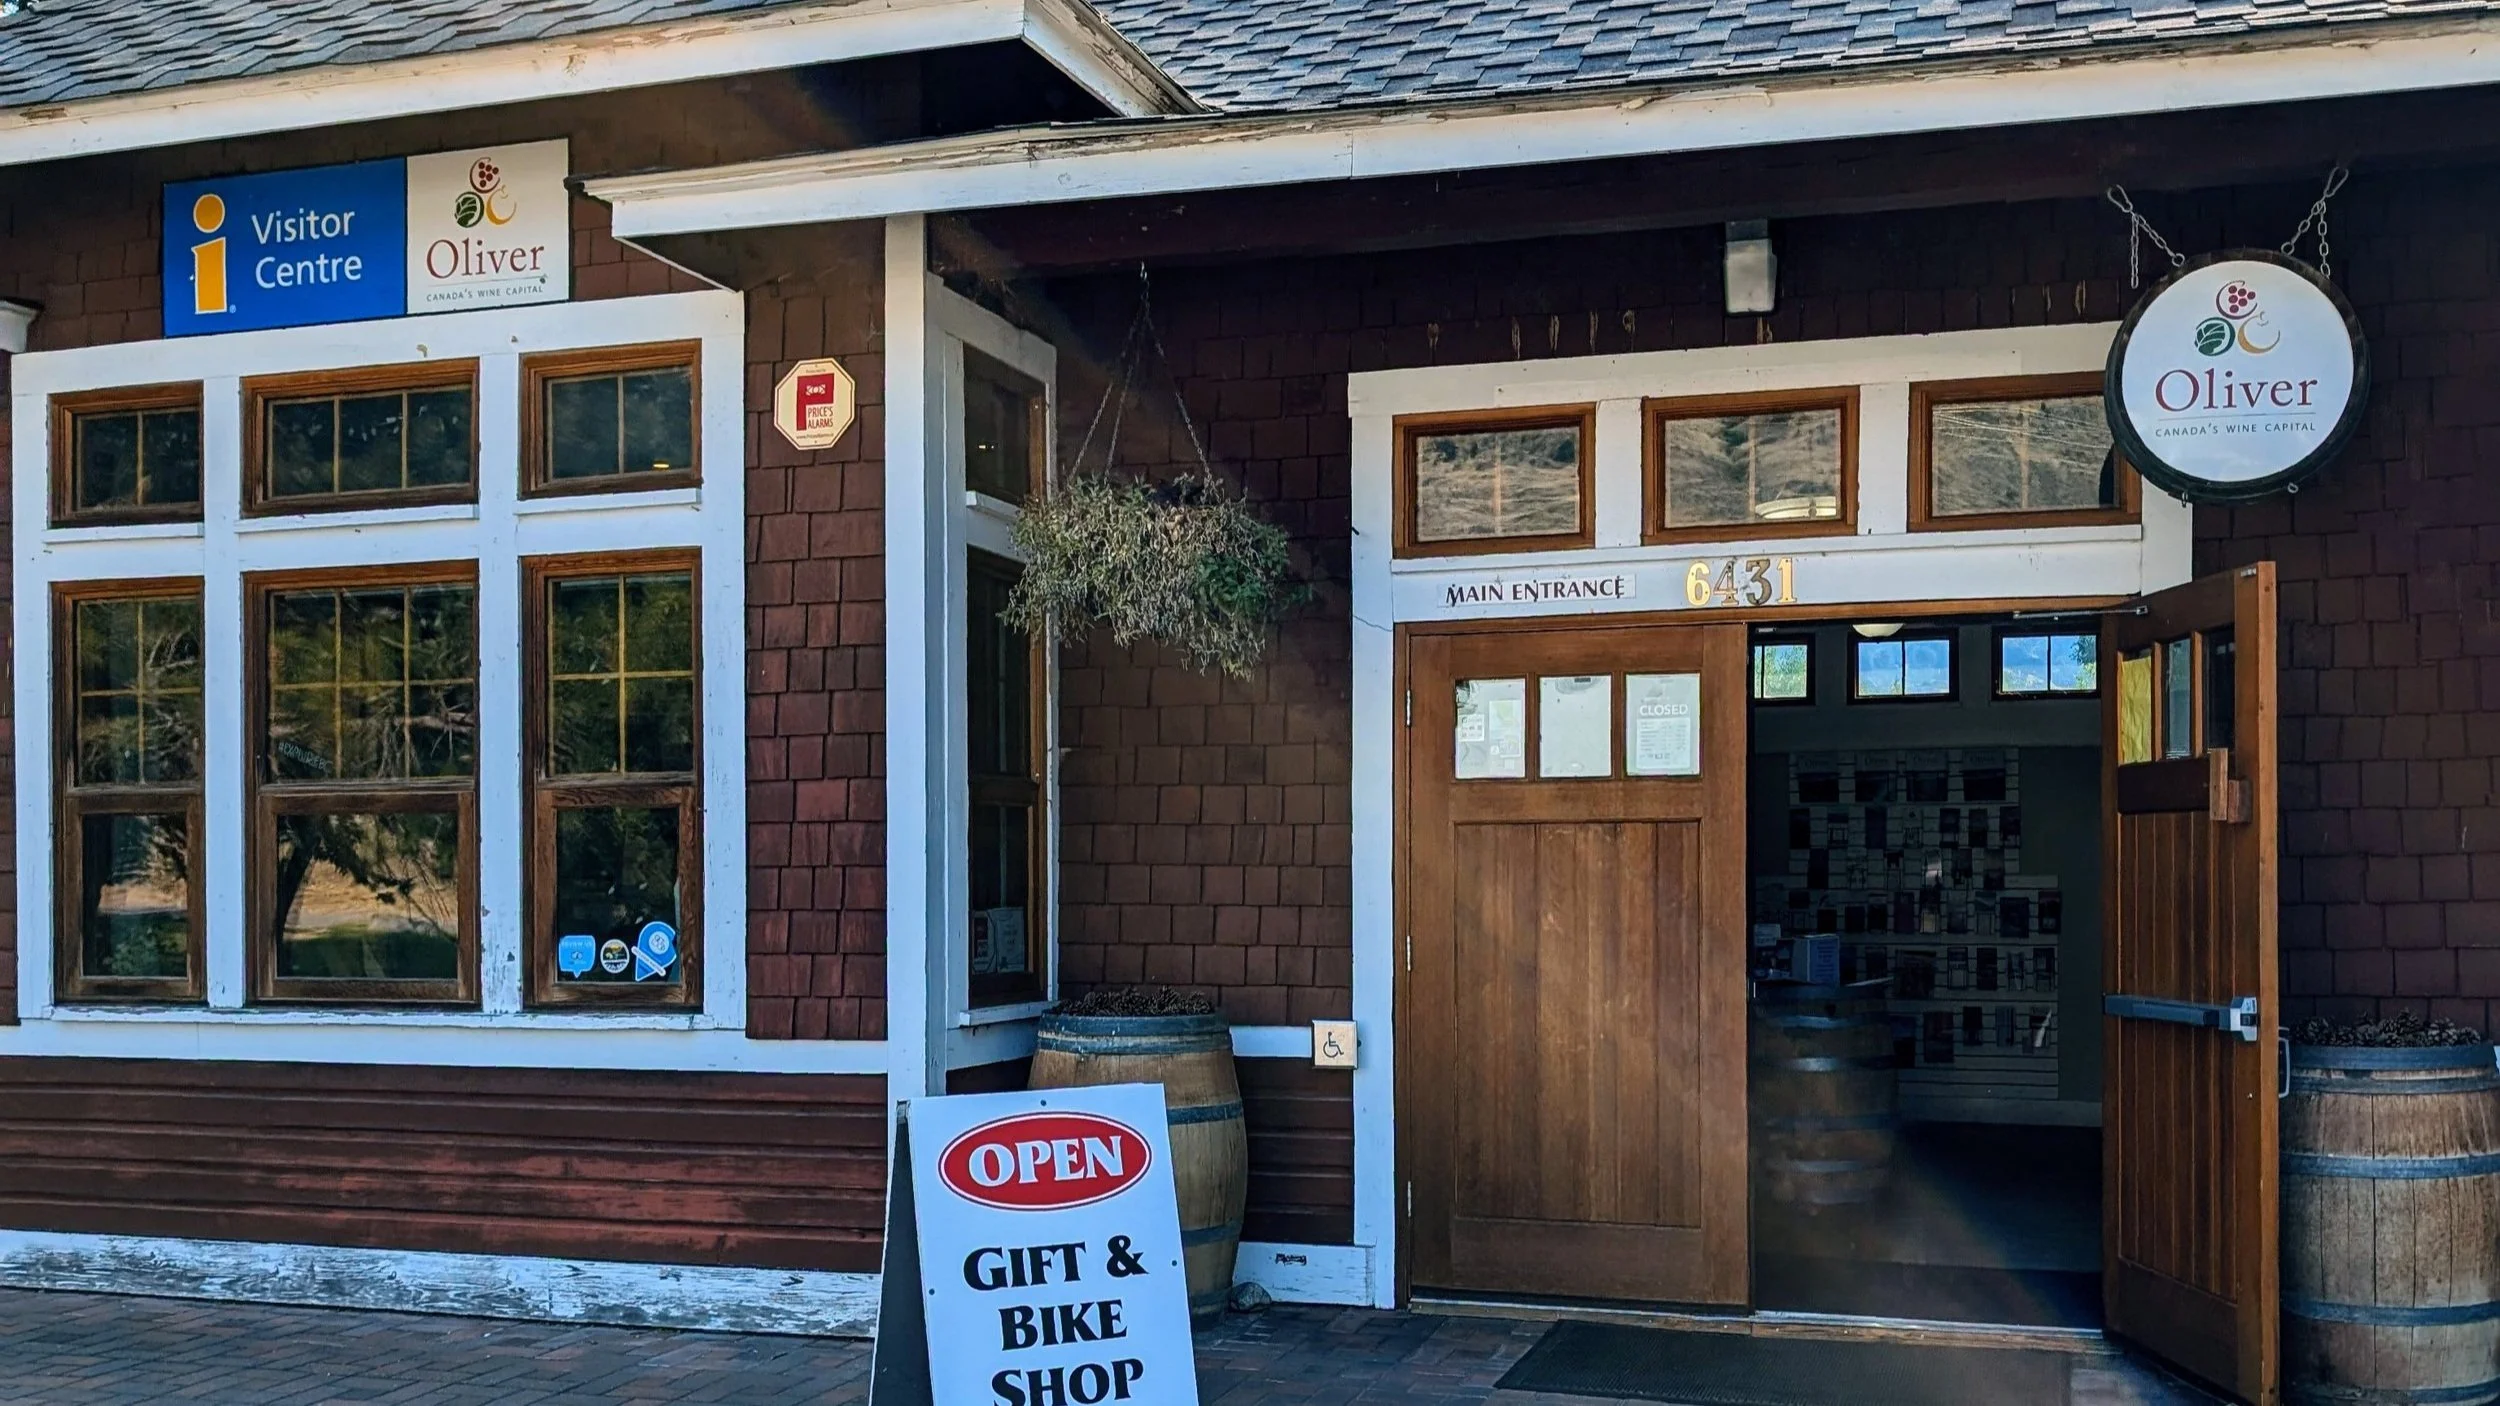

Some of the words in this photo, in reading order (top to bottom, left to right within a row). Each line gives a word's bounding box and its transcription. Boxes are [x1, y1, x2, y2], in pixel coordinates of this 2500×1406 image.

[251, 209, 355, 244] Visitor
[255, 253, 363, 290] Centre
[426, 237, 545, 279] Oliver
[426, 288, 473, 302] CANADA'S
[477, 288, 501, 298] WINE
[505, 285, 544, 296] CAPITAL
[2155, 367, 2318, 412] Oliver
[807, 406, 834, 418] PRICE'S
[807, 417, 834, 429] ALARMS
[2155, 423, 2219, 437] CANADA'S
[2226, 423, 2257, 434] WINE
[2264, 422, 2316, 432] CAPITAL
[1446, 584, 1503, 605] MAIN
[1512, 577, 1625, 602] ENTRANCE
[1686, 557, 1797, 607] 6431
[1639, 704, 1689, 716] CLOSED
[968, 1136, 1124, 1187] OPEN
[963, 1242, 1086, 1292] GIFT
[1106, 1235, 1149, 1278] &
[998, 1299, 1128, 1351] BIKE
[991, 1358, 1144, 1406] SHOP
